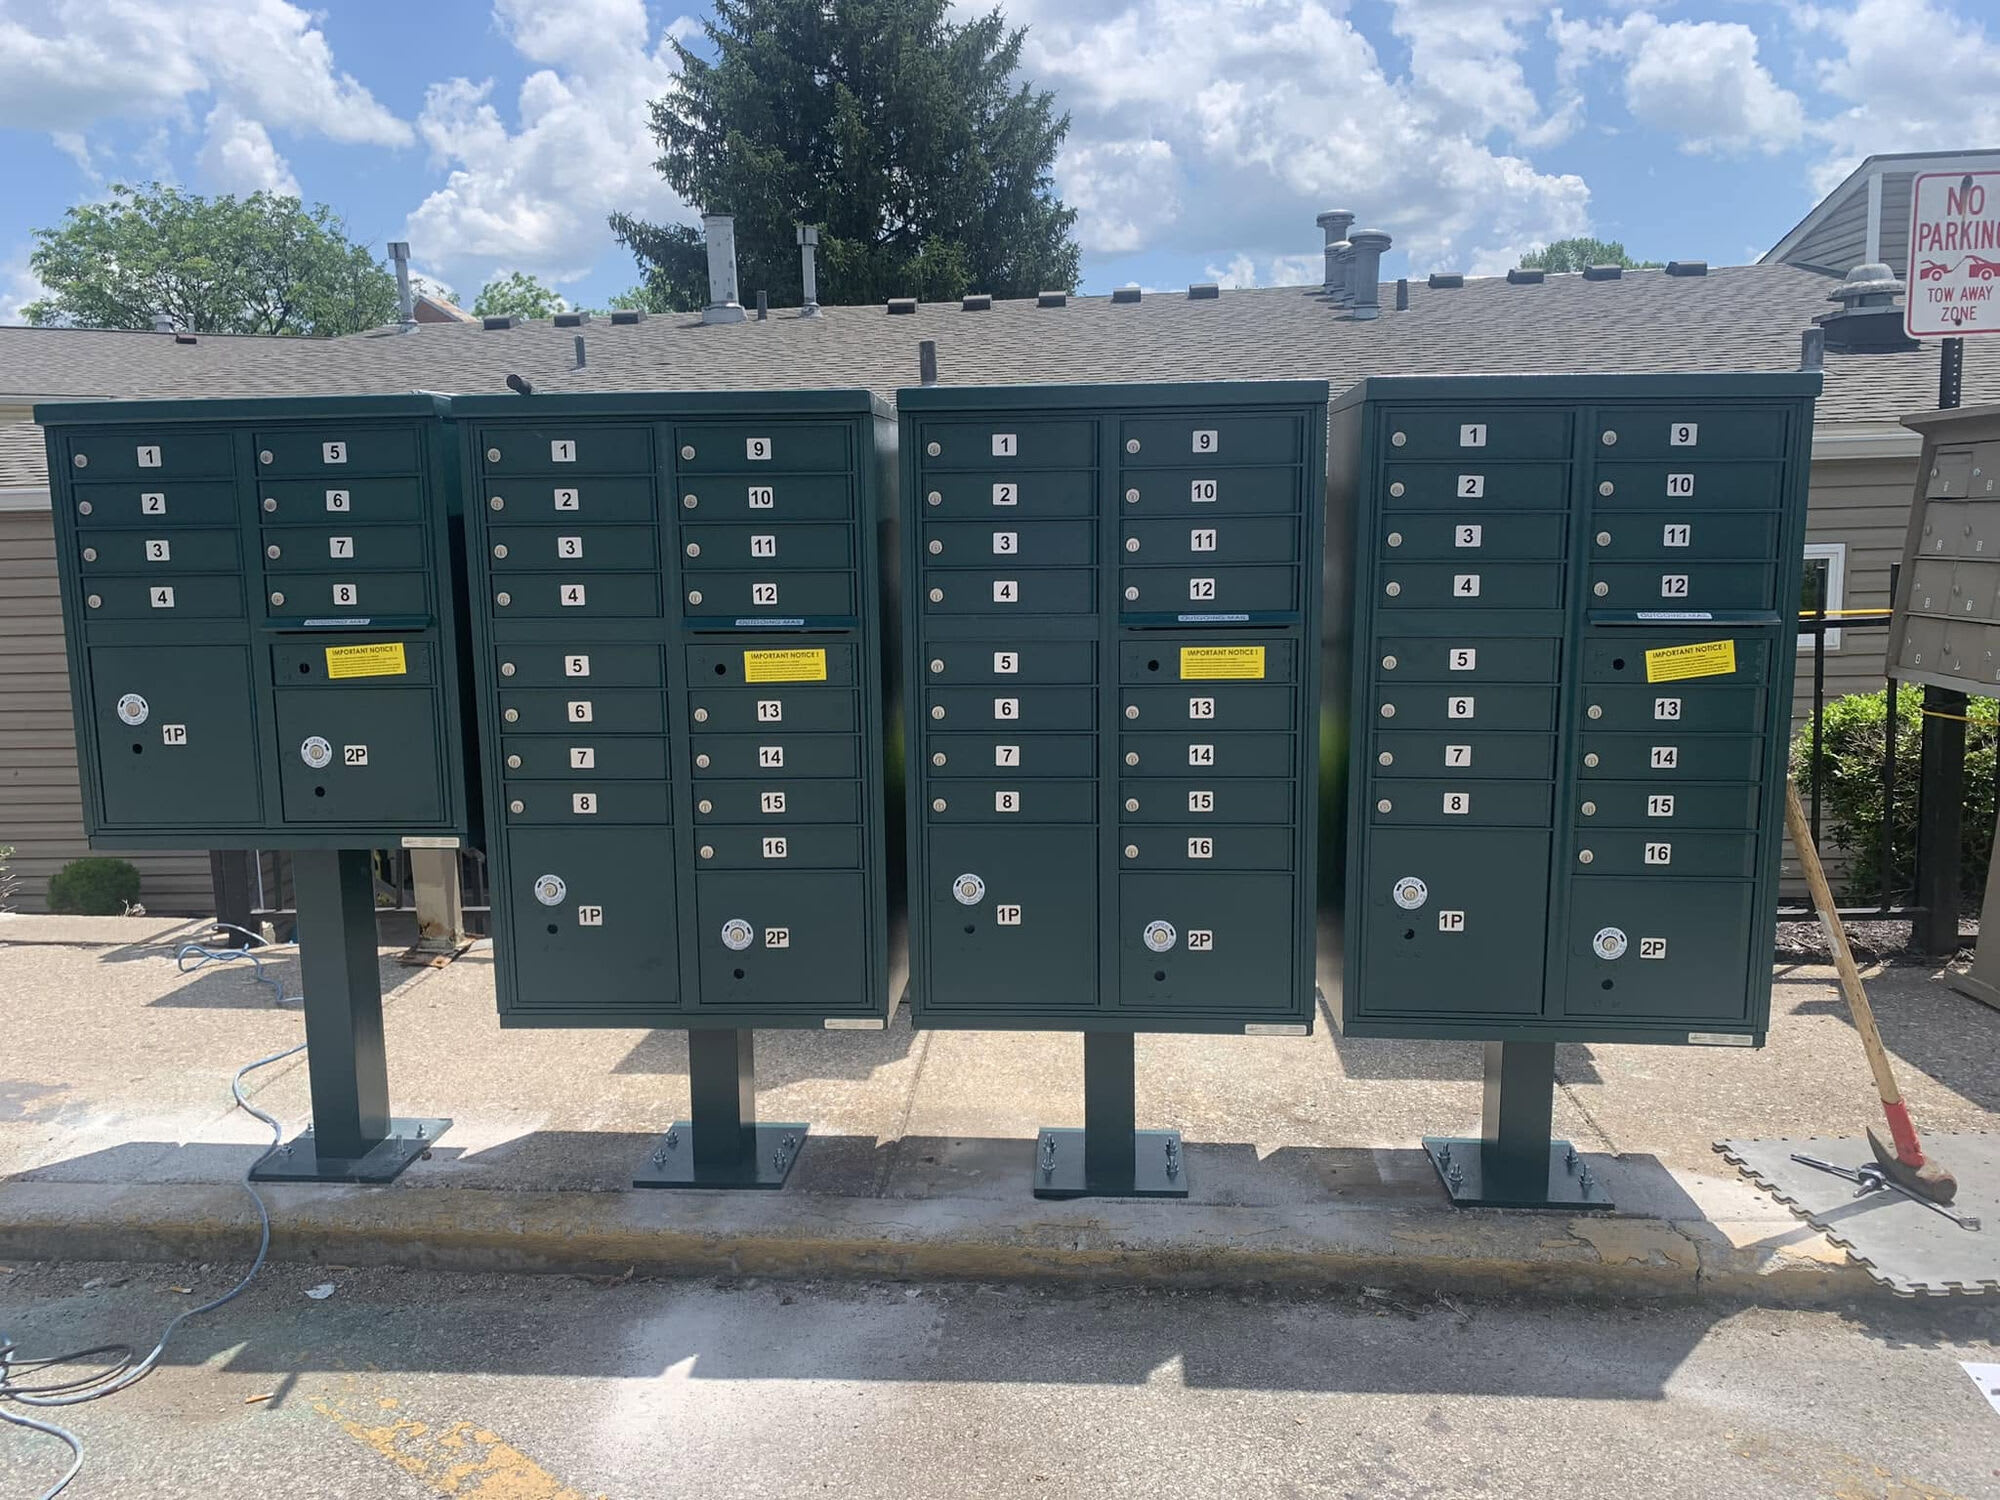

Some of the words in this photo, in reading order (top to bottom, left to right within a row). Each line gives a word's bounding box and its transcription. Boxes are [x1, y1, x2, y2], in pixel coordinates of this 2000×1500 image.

[1947, 185, 1985, 216] NO
[1928, 287, 1955, 303] TOW
[1960, 286, 1994, 301] AWAY
[1941, 306, 1977, 322] ZONE
[1200, 434, 1210, 450] 9
[1469, 427, 1478, 444] 1
[1678, 426, 1690, 443] 9
[330, 444, 340, 460] 5
[560, 443, 568, 459] 1
[754, 441, 764, 457] 9
[1001, 437, 1008, 453] 1
[145, 449, 154, 464] 1
[1194, 483, 1214, 499] 10
[1465, 478, 1477, 494] 2
[1670, 477, 1691, 493] 10
[333, 493, 343, 508] 6
[562, 492, 572, 507] 2
[751, 490, 771, 505] 10
[1000, 487, 1010, 502] 2
[148, 496, 159, 511] 2
[1000, 535, 1010, 551] 3
[1194, 533, 1213, 548] 11
[1463, 528, 1474, 544] 3
[1667, 528, 1687, 544] 11
[153, 543, 163, 558] 3
[336, 540, 346, 555] 7
[565, 540, 575, 555] 3
[754, 538, 772, 554] 11
[1000, 584, 1011, 599] 4
[1192, 581, 1213, 597] 12
[1461, 578, 1472, 593] 4
[1664, 578, 1686, 594] 12
[157, 590, 168, 604] 4
[340, 587, 350, 602] 8
[568, 588, 579, 602] 4
[755, 586, 775, 602] 12
[332, 648, 368, 656] IMPORTANT
[370, 646, 393, 654] NOTICE
[751, 652, 790, 660] IMPORTANT
[1653, 648, 1693, 659] IMPORTANT
[1695, 644, 1722, 653] NOTICE
[573, 658, 582, 673] 5
[1001, 655, 1011, 670] 5
[1457, 652, 1468, 667] 5
[575, 704, 585, 719] 6
[760, 703, 779, 718] 13
[1002, 701, 1012, 716] 6
[1192, 701, 1212, 716] 13
[1456, 700, 1466, 715] 6
[1657, 701, 1678, 717] 13
[164, 727, 184, 742] 1P
[346, 748, 366, 762] 2P
[577, 751, 587, 765] 7
[761, 750, 781, 764] 14
[1003, 748, 1013, 763] 7
[1191, 748, 1212, 762] 14
[1453, 748, 1464, 763] 7
[1654, 750, 1675, 765] 14
[580, 796, 590, 811] 8
[763, 795, 783, 810] 15
[1002, 794, 1012, 809] 8
[1191, 794, 1211, 809] 15
[1451, 796, 1461, 811] 8
[1650, 798, 1671, 813] 15
[765, 840, 785, 855] 16
[1190, 840, 1210, 855] 16
[1647, 846, 1668, 861] 16
[580, 908, 601, 922] 1P
[998, 908, 1020, 922] 1P
[1440, 914, 1463, 928] 1P
[767, 931, 788, 945] 2P
[1190, 933, 1211, 947] 2P
[1641, 941, 1664, 956] 2P
